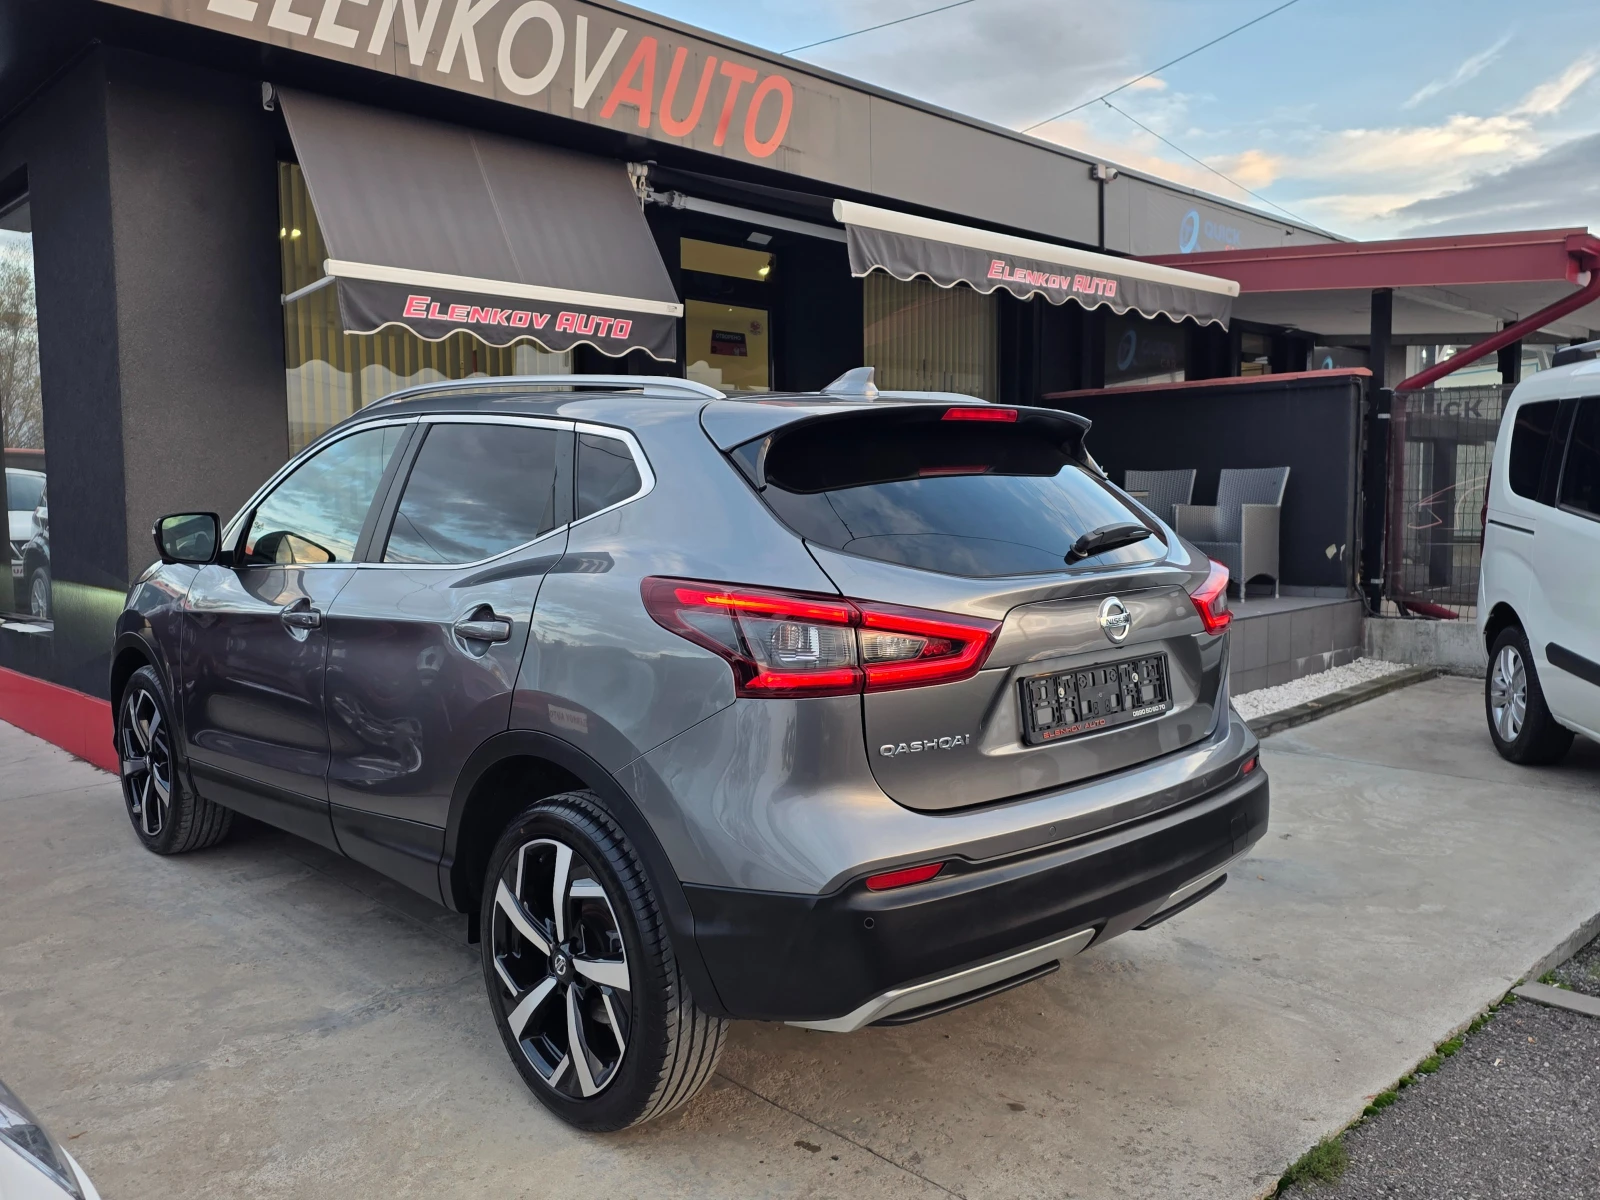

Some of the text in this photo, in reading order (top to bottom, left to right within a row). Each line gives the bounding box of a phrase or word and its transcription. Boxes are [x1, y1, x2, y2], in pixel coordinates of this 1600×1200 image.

[987, 259, 1117, 297] ELENKOV AUTO
[403, 294, 632, 340] ELENKOV AUTO
[1043, 718, 1106, 739] ELENKOV AUTO
[880, 734, 969, 757] QASHQAI
